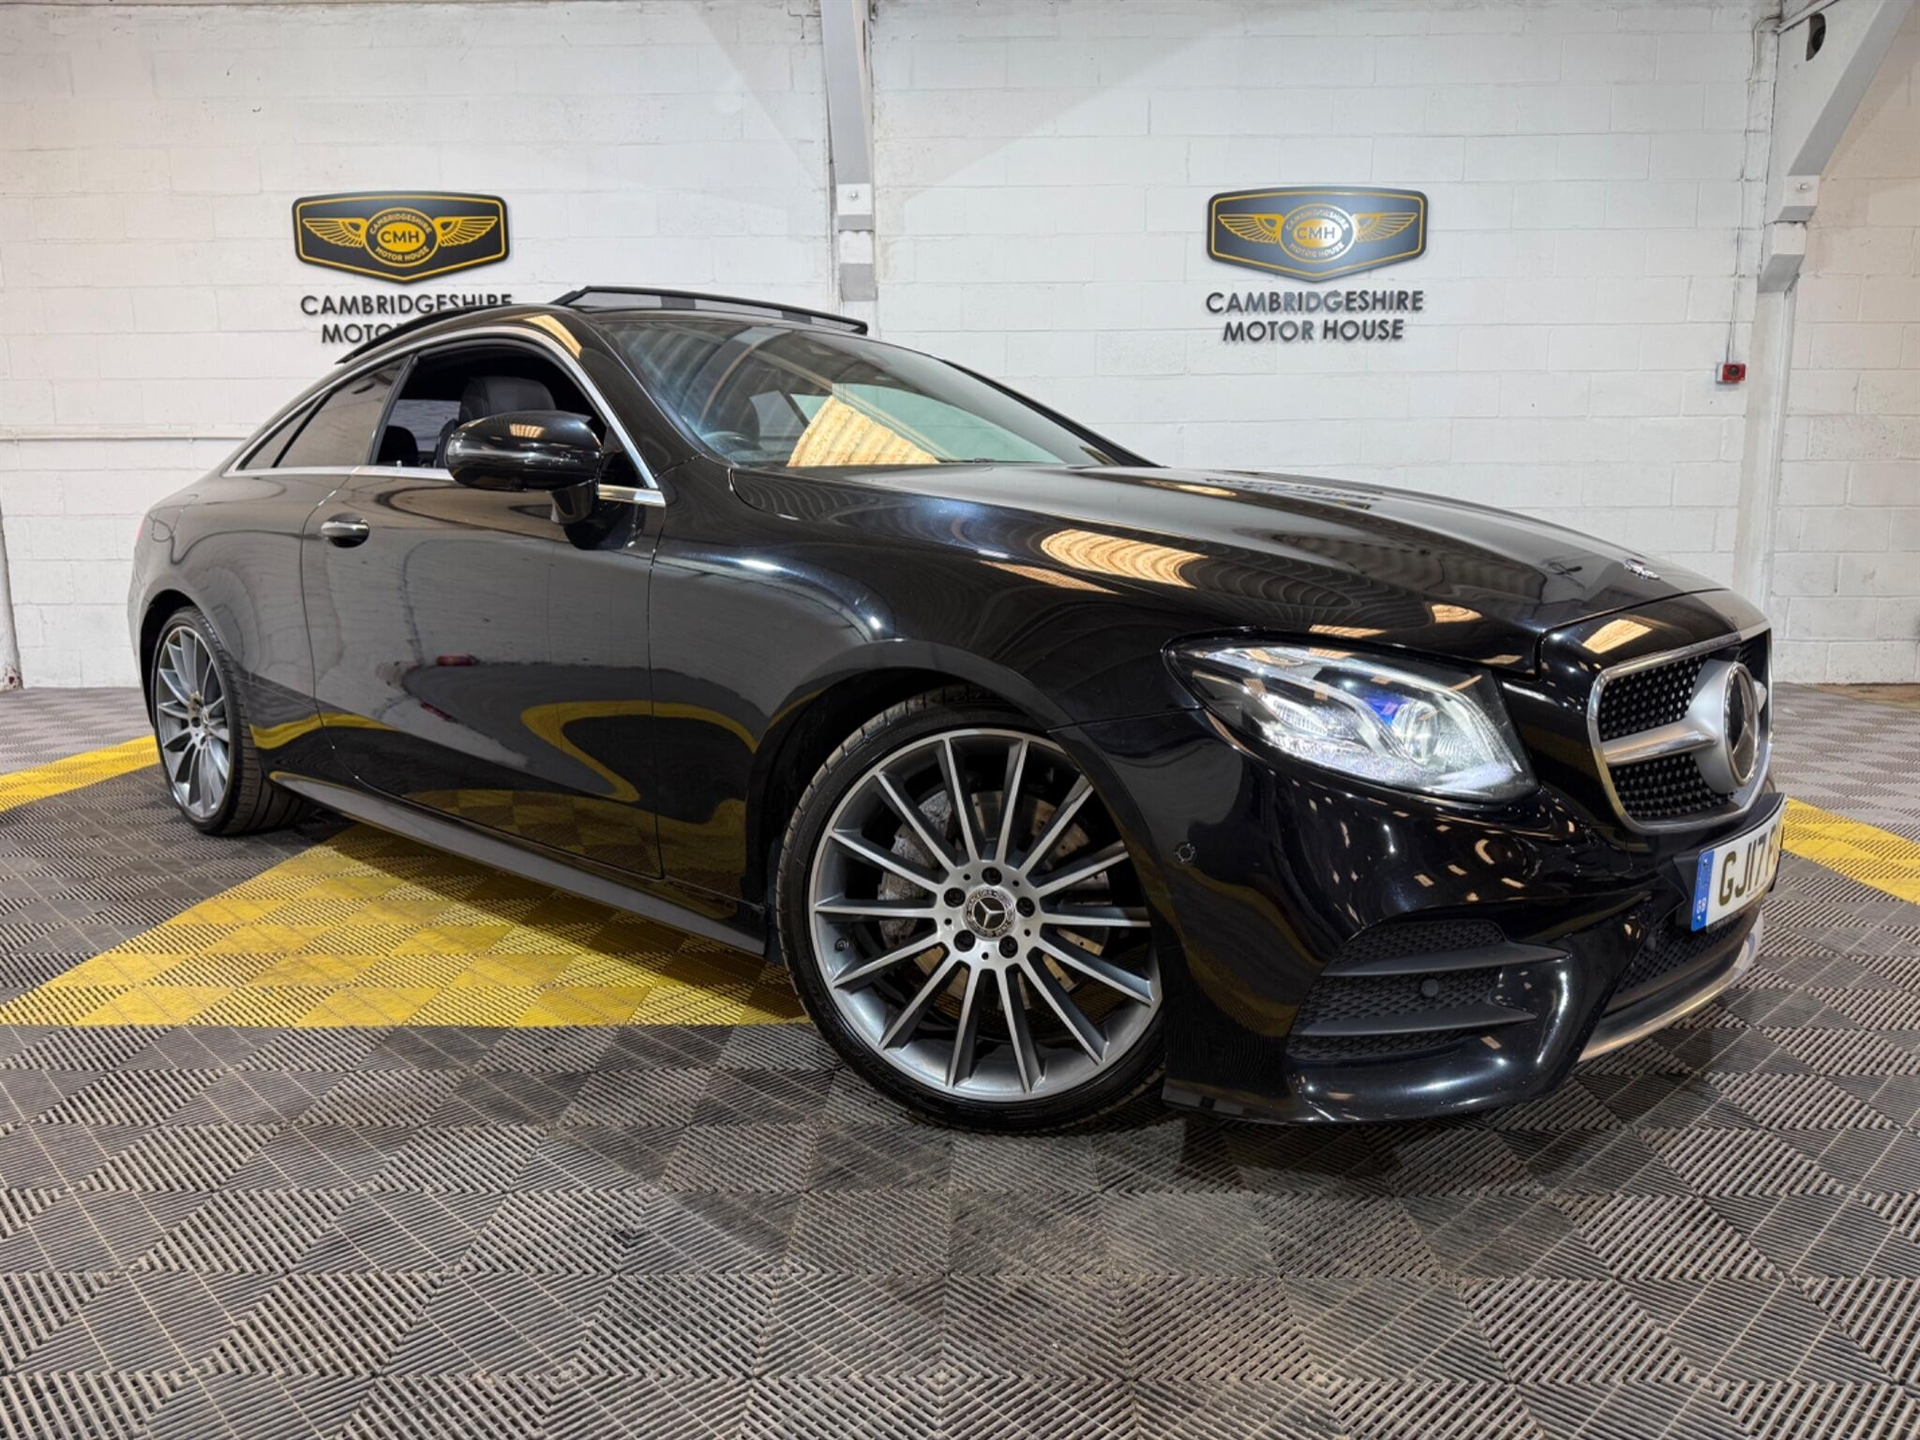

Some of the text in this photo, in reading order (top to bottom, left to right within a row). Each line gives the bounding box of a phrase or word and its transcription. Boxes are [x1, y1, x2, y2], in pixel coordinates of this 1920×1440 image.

[369, 213, 432, 235] CAMBRIDGESHIRE
[1297, 226, 1335, 240] CMH
[380, 230, 419, 243] CMH
[375, 246, 430, 261] MOTOR HOUSE
[1290, 241, 1345, 257] MOTOR HOUSE
[1206, 290, 1424, 313] CAMBRIDGESHIRE
[322, 323, 402, 343] MOTO
[1223, 319, 1404, 342] MOTOR HOUSE
